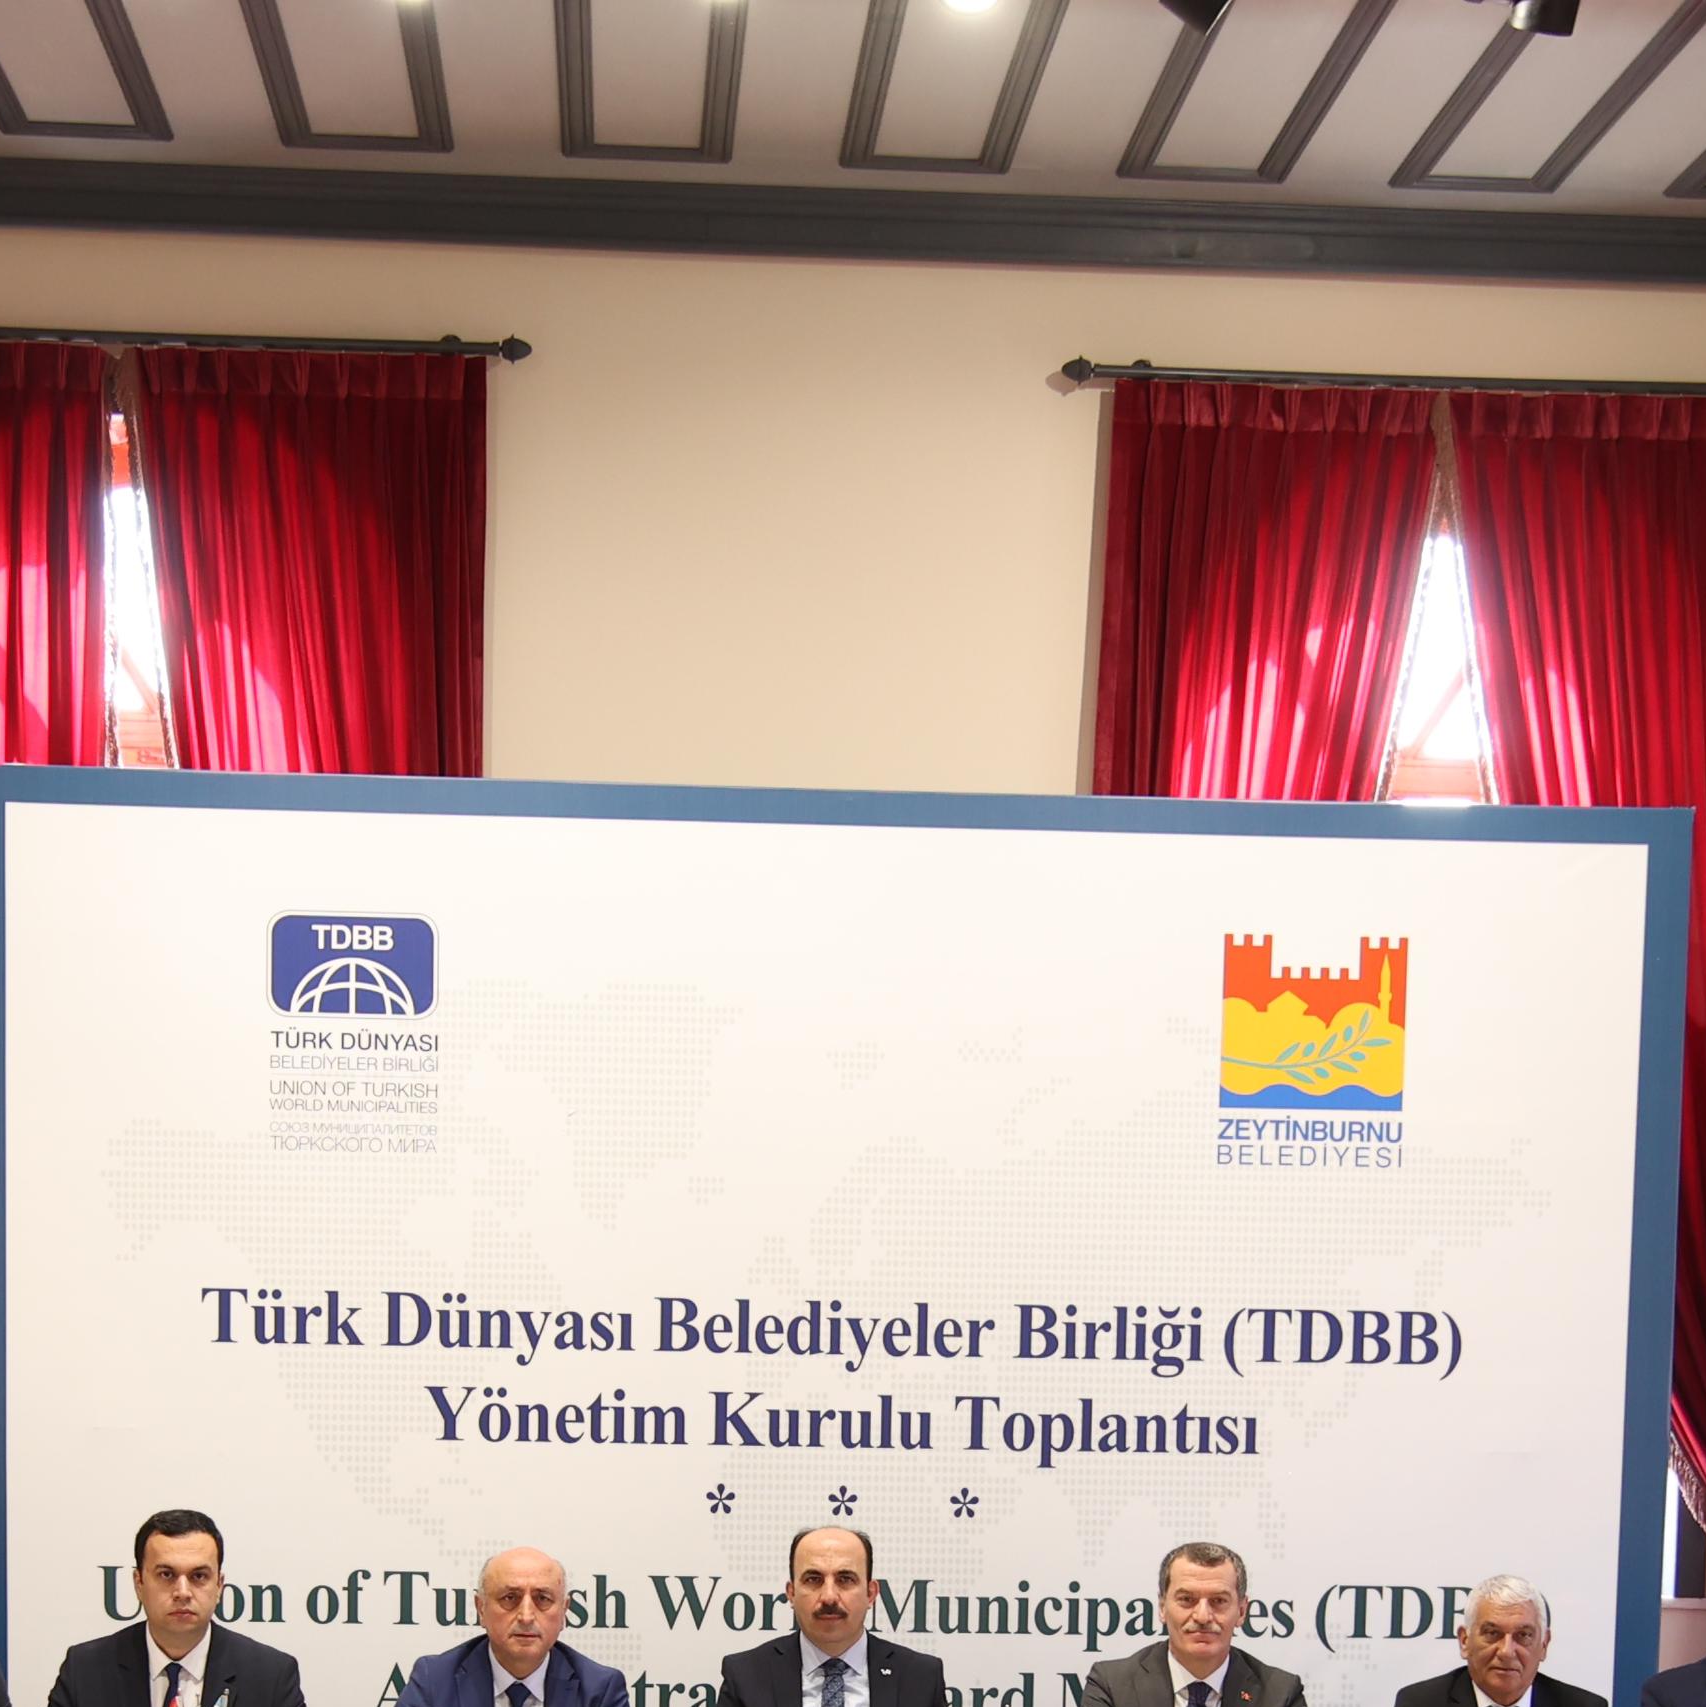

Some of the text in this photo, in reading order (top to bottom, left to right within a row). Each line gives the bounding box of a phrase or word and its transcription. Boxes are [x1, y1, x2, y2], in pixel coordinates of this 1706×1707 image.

[311, 923, 395, 951] TDBB
[270, 1026, 439, 1052] TÜRK DÜNYASI
[269, 1053, 439, 1073] BELEDİYELER BİRLİĞİ
[269, 1079, 439, 1099] UNION OF TURKISH
[269, 1098, 438, 1114] WORLD MUNICIPALITIES
[1217, 1115, 1403, 1144] ZEYTİNBURNU
[387, 1137, 438, 1154] МИРА
[1216, 1143, 1403, 1168] BELEDİYESİ
[201, 1287, 1463, 1381] Türk Dünyası Belediyeler Birliği (TDBB)
[424, 1385, 1260, 1469] Yönetim Kurulu Toplantısı
[97, 1565, 285, 1625] Uon
[306, 1568, 372, 1626] of
[383, 1570, 630, 1630] Tush
[648, 1574, 801, 1632] Wor
[867, 1578, 1296, 1653] Municipaes
